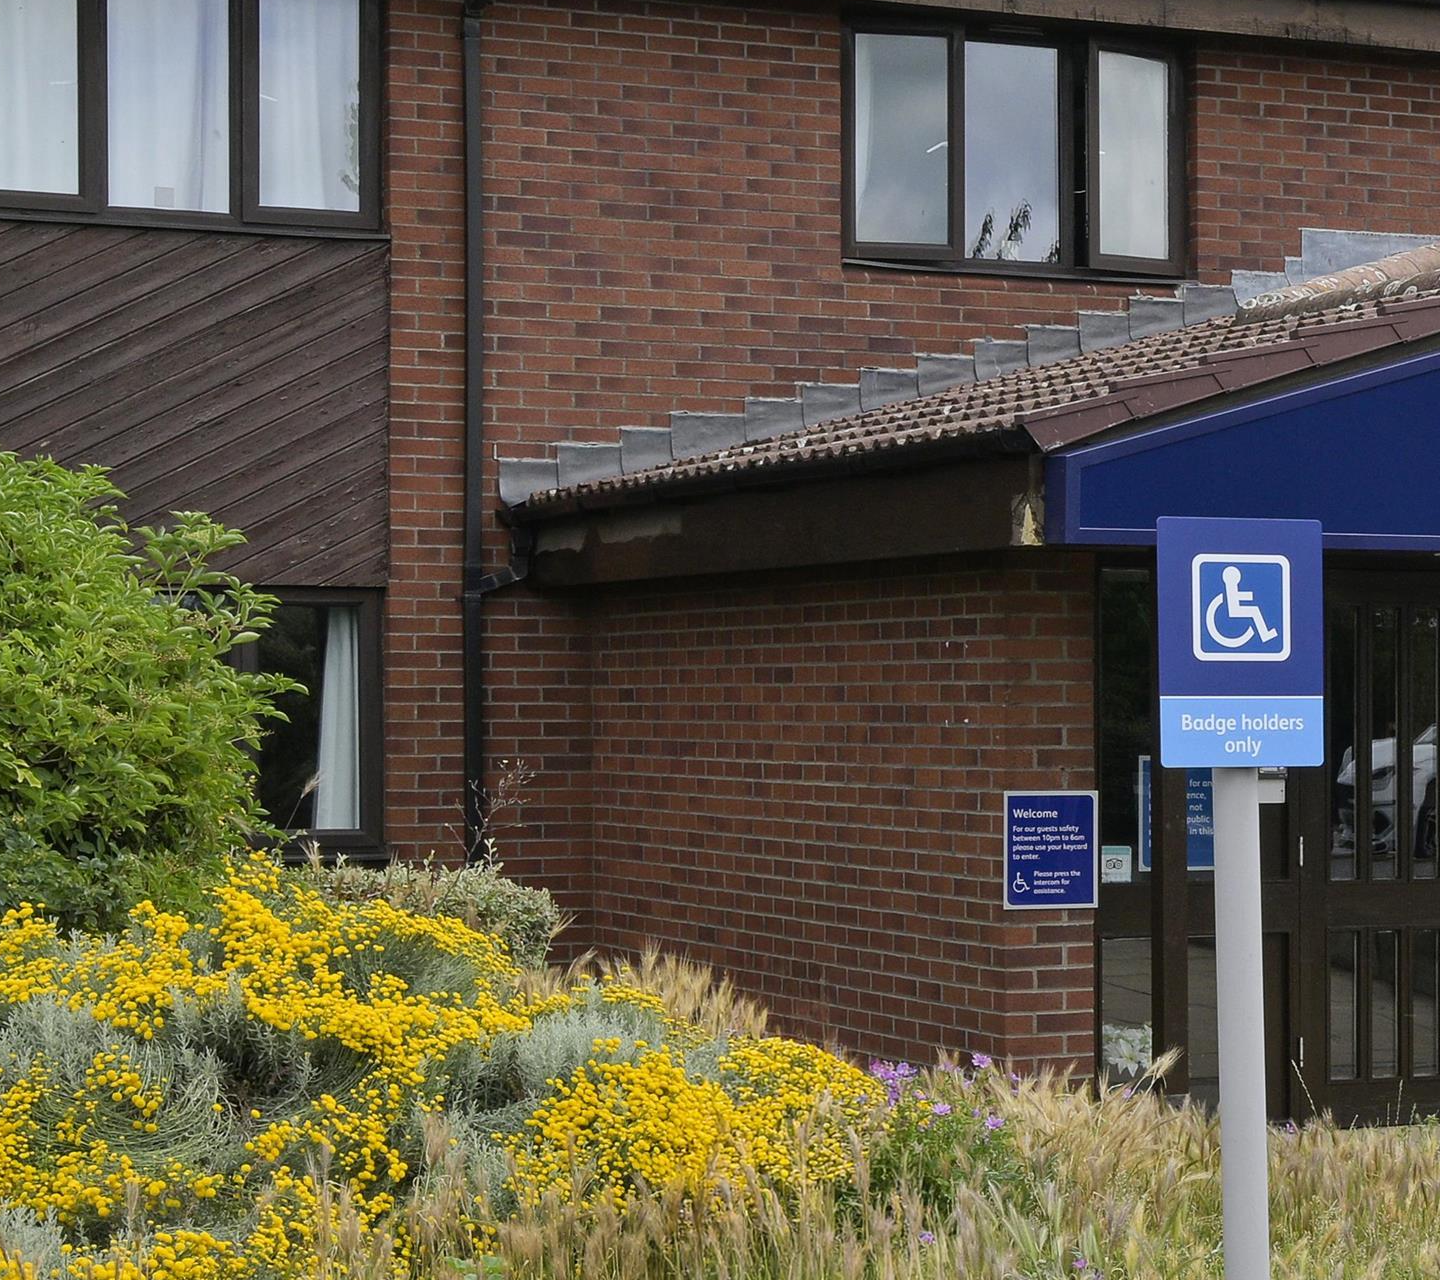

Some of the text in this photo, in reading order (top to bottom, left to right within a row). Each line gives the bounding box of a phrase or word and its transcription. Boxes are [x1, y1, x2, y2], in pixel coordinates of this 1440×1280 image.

[1181, 714, 1304, 735] Badge holders
[1225, 736, 1262, 757] only
[1189, 779, 1200, 787] for
[1013, 809, 1058, 819] Welcome
[1186, 815, 1210, 824] public
[1037, 826, 1057, 834] guests
[1059, 825, 1079, 833] safety
[1189, 827, 1197, 835] in
[1043, 834, 1060, 842] 10pm
[1013, 844, 1033, 852] please
[1063, 843, 1087, 852] keycard
